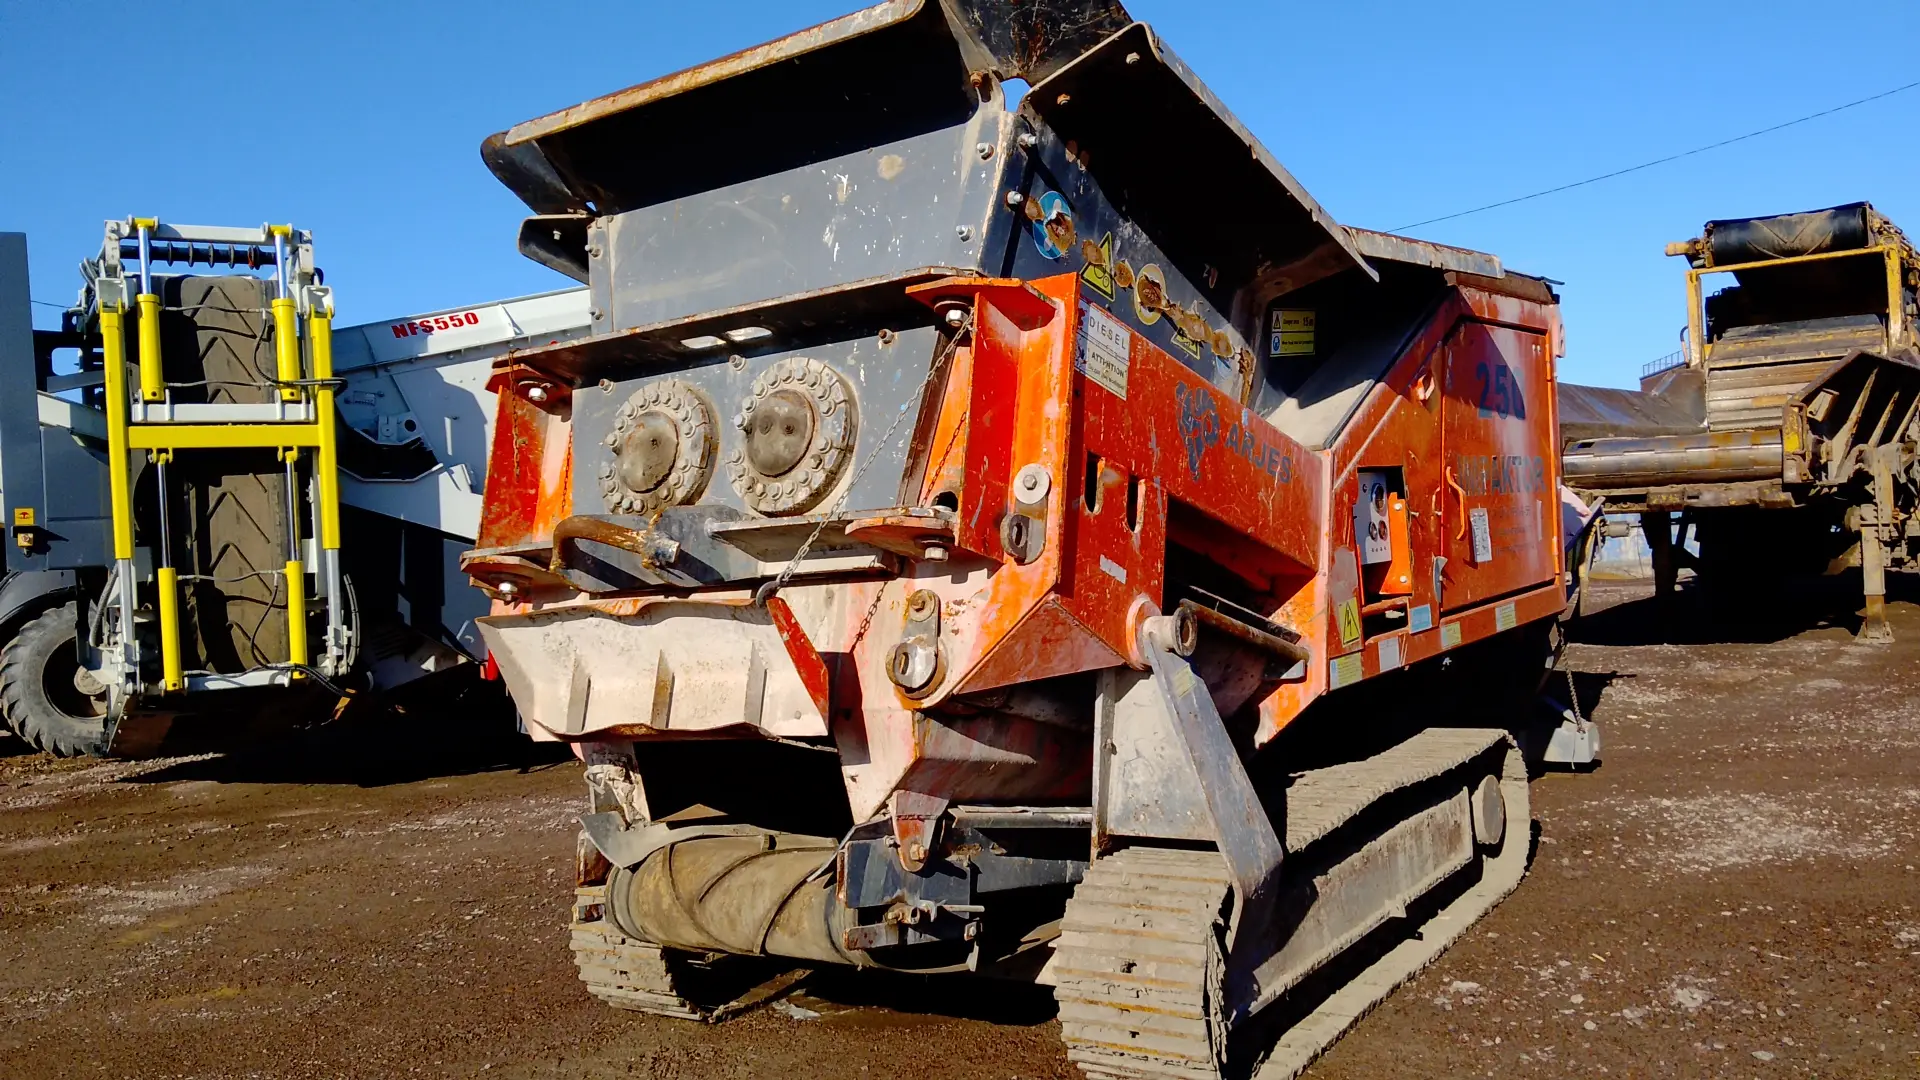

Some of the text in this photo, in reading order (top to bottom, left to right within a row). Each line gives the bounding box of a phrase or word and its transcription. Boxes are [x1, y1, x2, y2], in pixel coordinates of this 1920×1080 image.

[391, 312, 479, 339] NFS550
[1089, 316, 1126, 350] DIESEL
[1091, 351, 1125, 378] ATTENTION
[1476, 361, 1526, 420] 250
[1225, 422, 1291, 484] ARJES
